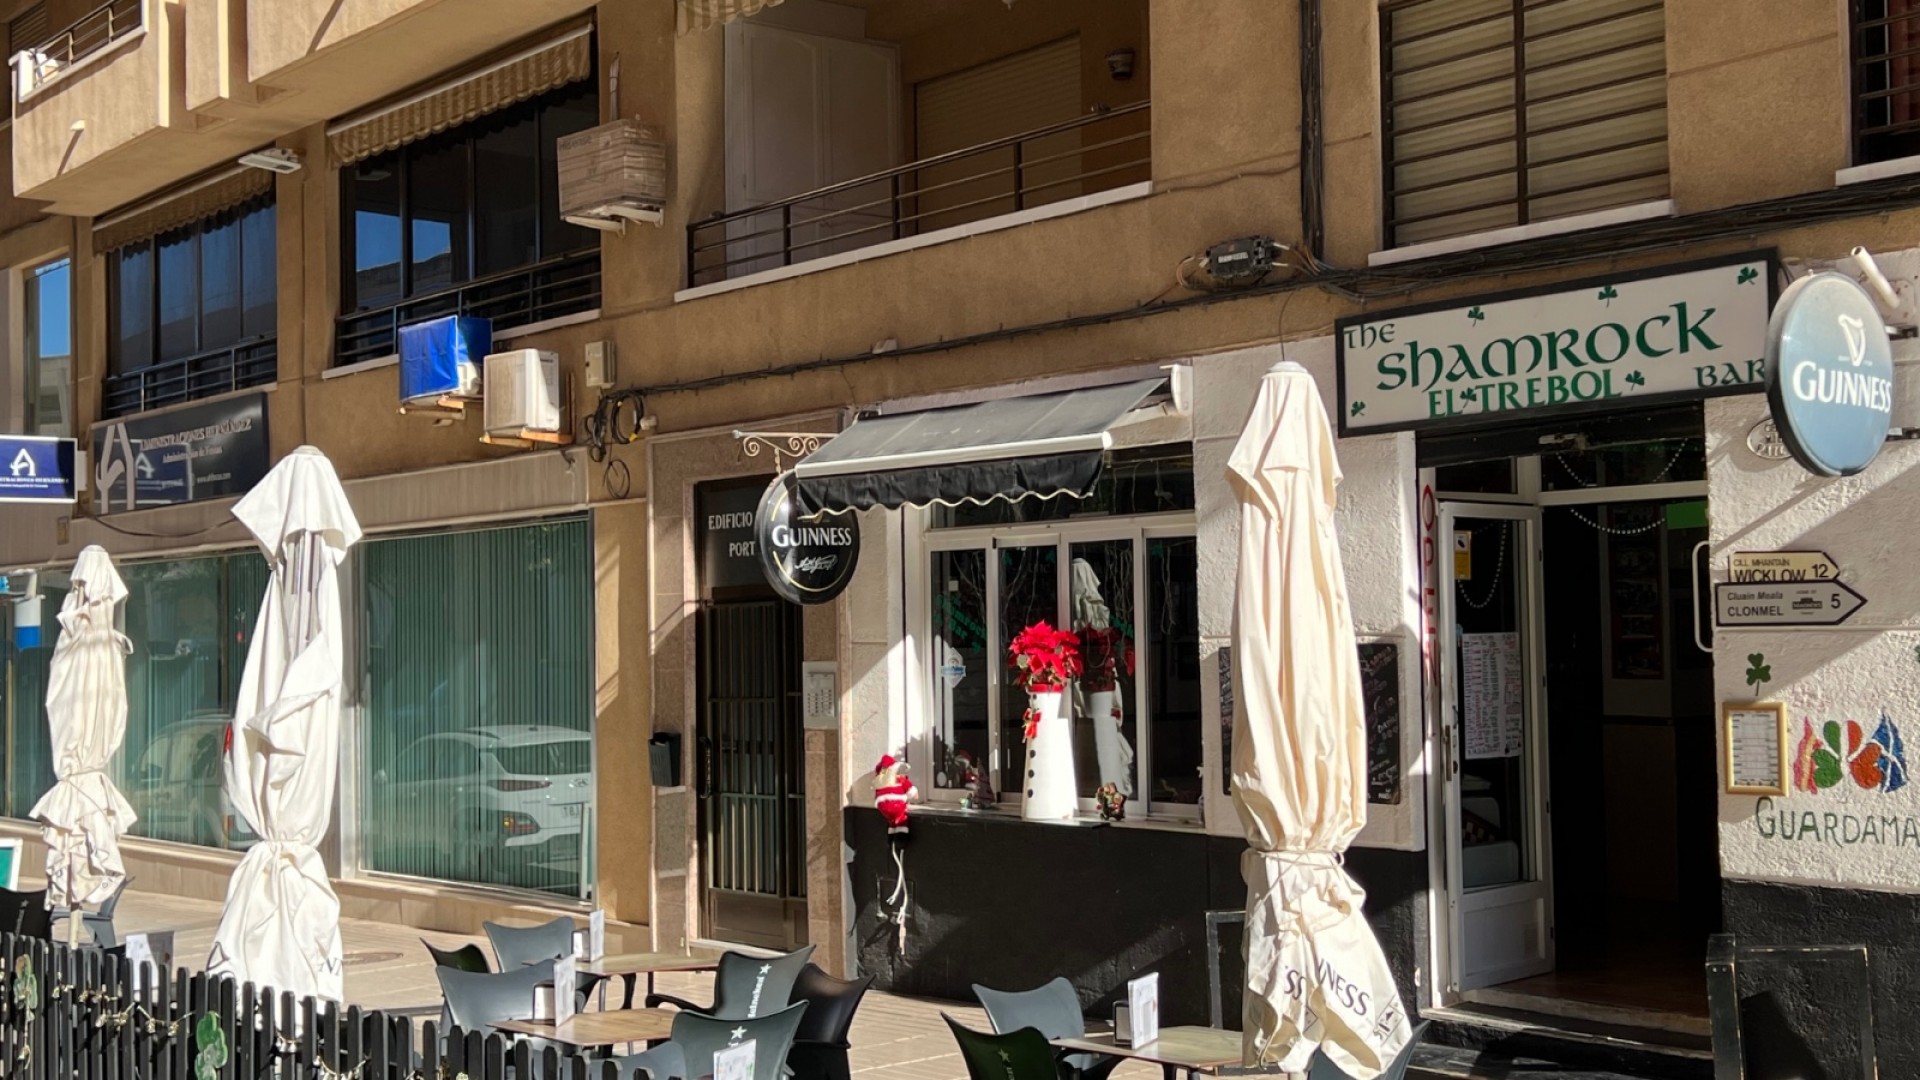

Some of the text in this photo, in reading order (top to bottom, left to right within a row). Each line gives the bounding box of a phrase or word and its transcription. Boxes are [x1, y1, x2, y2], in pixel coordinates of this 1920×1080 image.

[1428, 369, 1623, 419] EL TREBOL
[1791, 360, 1893, 414] GUINNESS
[708, 511, 753, 530] EDIFICIO
[771, 524, 852, 547] GUINNESS
[1811, 563, 1829, 579] 12
[1727, 591, 1755, 600] Cluain
[1830, 593, 1841, 609] 5
[1727, 605, 1784, 617] CLONMEL
